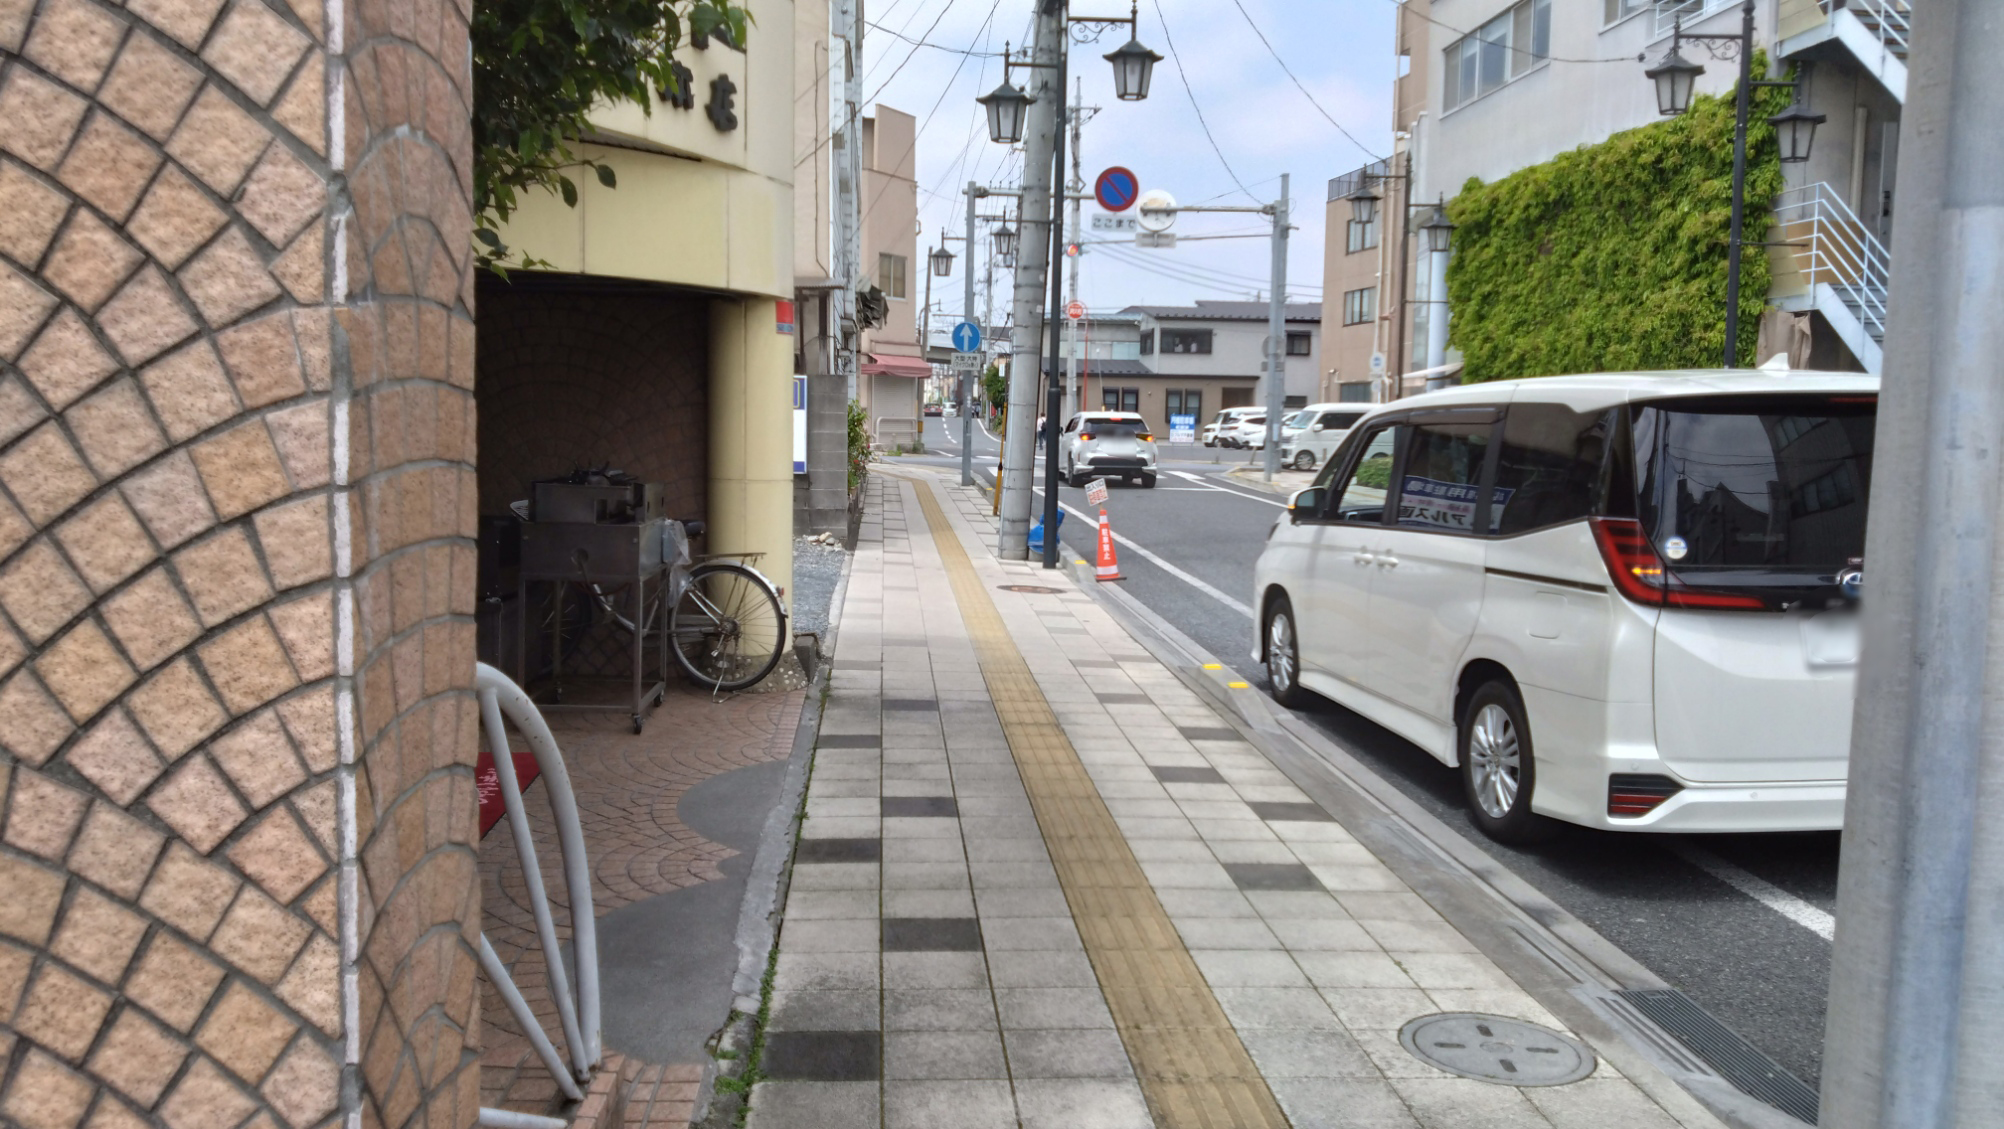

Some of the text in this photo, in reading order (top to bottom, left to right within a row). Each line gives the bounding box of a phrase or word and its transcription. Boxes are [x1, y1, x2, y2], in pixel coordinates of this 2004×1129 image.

[1092, 217, 1136, 229] ここまで
[1101, 528, 1111, 560] 駐車禁止
